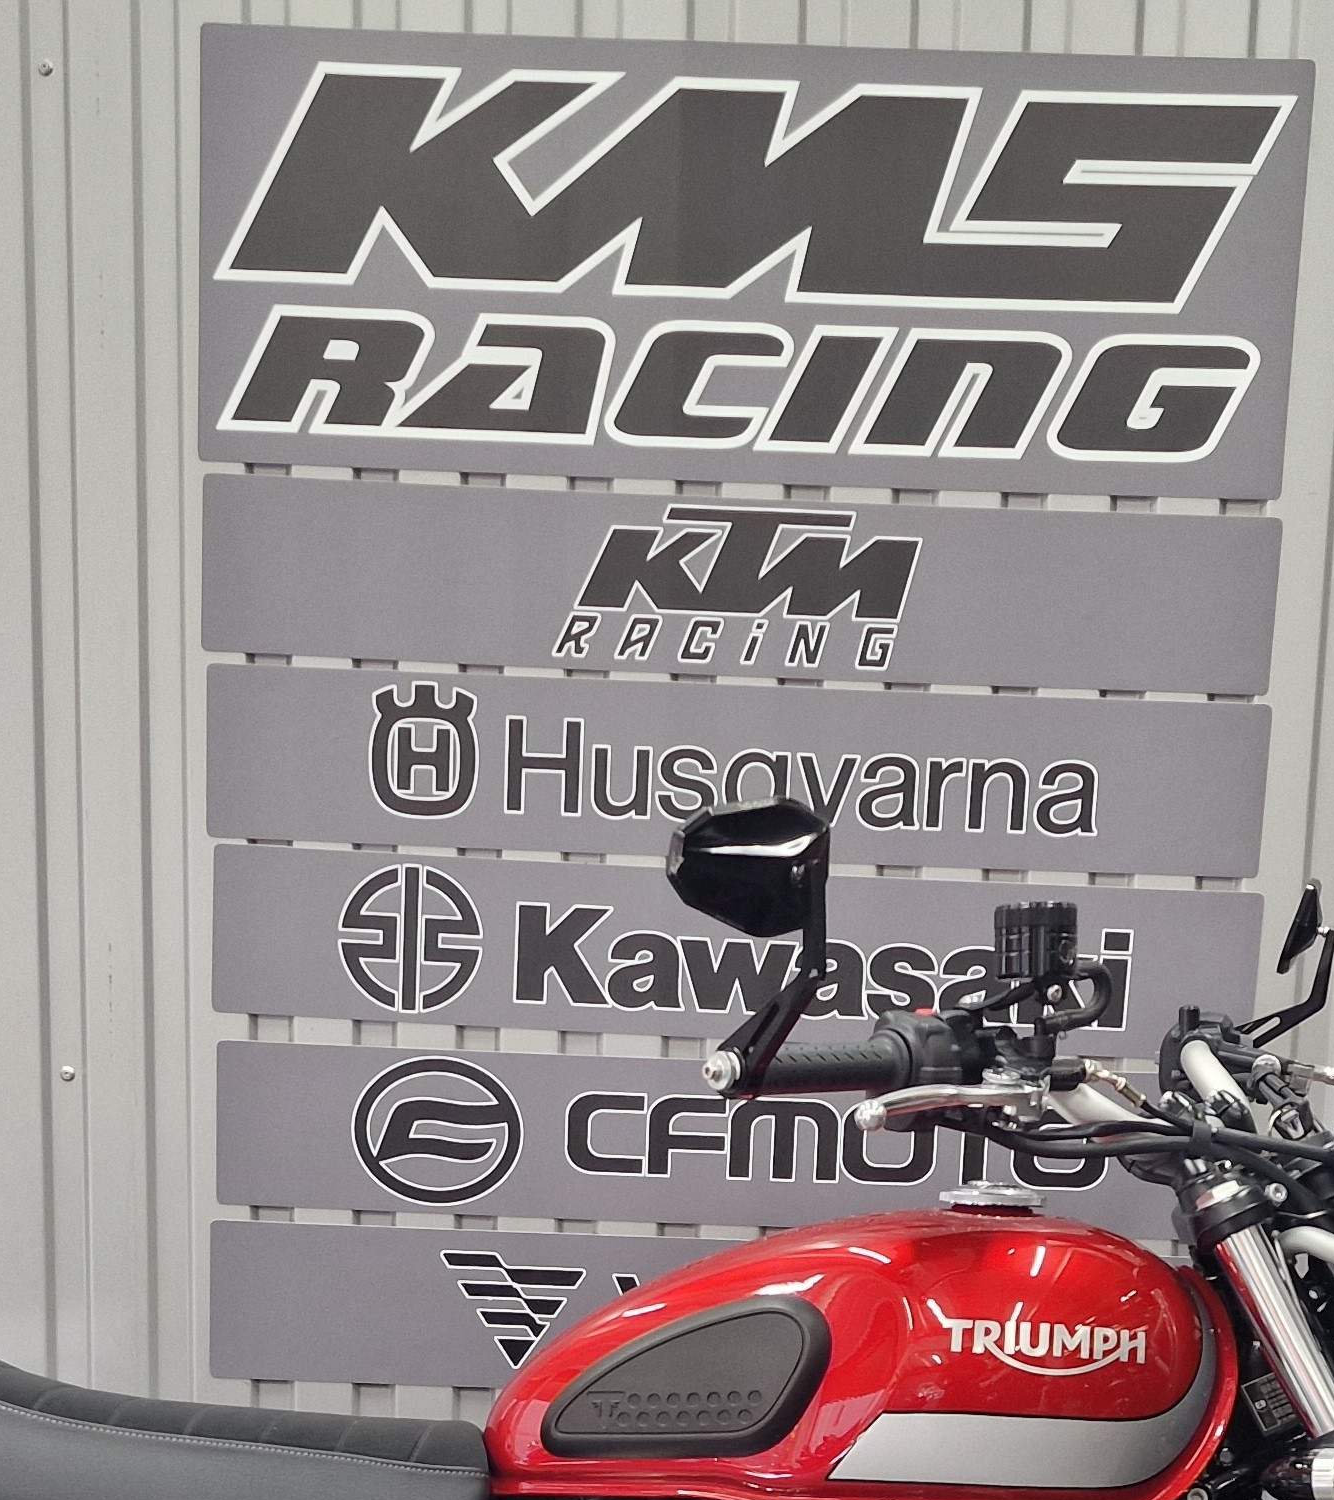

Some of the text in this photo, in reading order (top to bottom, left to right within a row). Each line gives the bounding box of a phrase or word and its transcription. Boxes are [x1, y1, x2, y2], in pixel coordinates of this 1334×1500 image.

[214, 62, 1297, 313] KMS
[216, 304, 1261, 463] RACING
[574, 504, 923, 623] KTM
[513, 902, 1134, 1031] Kawasai
[943, 1317, 1146, 1377] TRIUMPH
